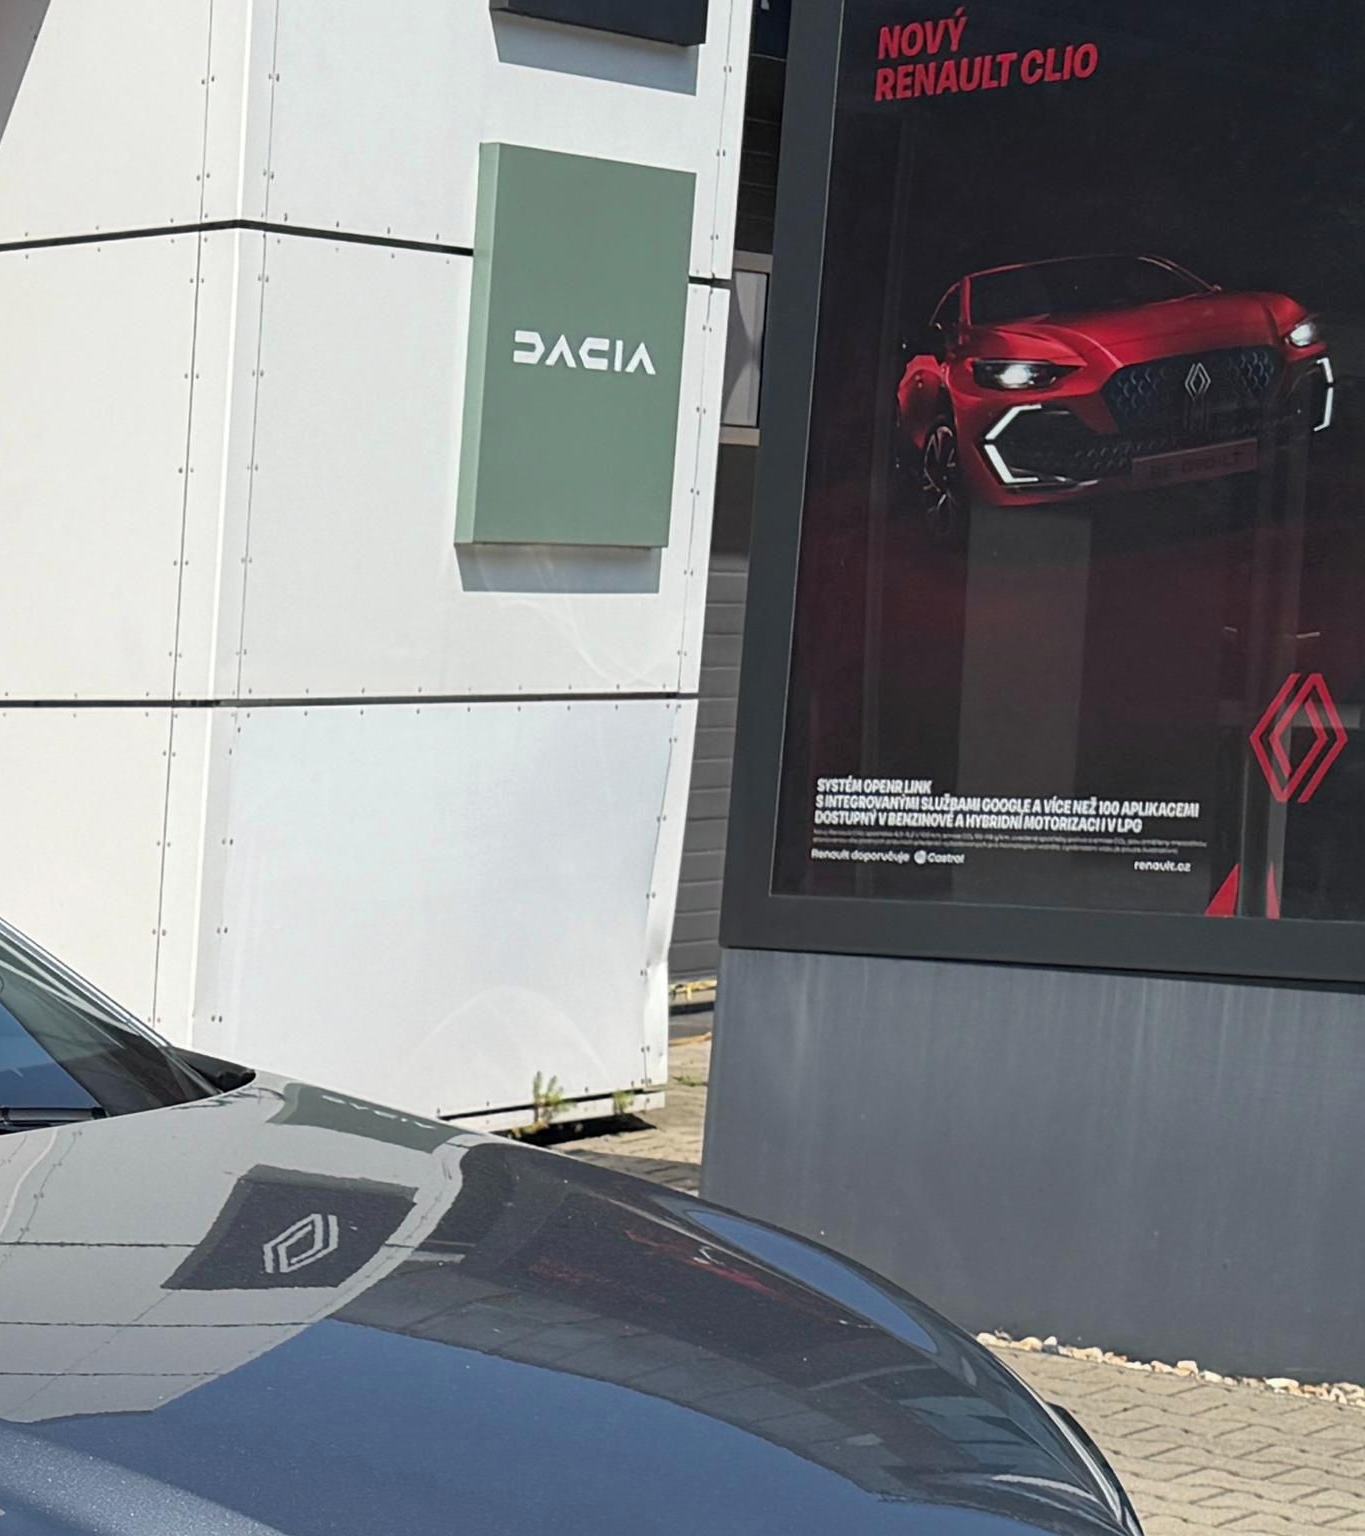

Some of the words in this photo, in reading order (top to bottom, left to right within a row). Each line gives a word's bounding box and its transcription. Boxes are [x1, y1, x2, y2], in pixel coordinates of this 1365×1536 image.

[877, 6, 968, 60] NOVÝ
[874, 52, 1018, 102] RENAULT
[1021, 42, 1098, 85] CLIO
[513, 330, 656, 375] DACIA
[817, 775, 862, 793] SYSTÉM
[863, 778, 903, 794] OPENR
[904, 779, 933, 794] LINK
[815, 794, 824, 808] S
[825, 793, 920, 811] INTEGROVANÝMI
[921, 793, 981, 812] SLUŽBAMI
[981, 797, 1032, 814] GOOGLE
[1032, 799, 1042, 814] A
[1043, 795, 1071, 815] VÍCE
[1072, 796, 1097, 815] NEŽ
[1098, 799, 1119, 816] 100
[1120, 801, 1200, 818] APLIKACEMI
[814, 809, 878, 826] DOSTUPNÝ
[878, 811, 888, 826] V
[887, 810, 954, 828] BENZINOVÉ
[954, 813, 965, 828] A
[965, 811, 1023, 830] HYBRIDNÍ
[1023, 815, 1100, 833] MOTORIZACI
[1107, 818, 1118, 833] V
[1118, 818, 1143, 833] LPG
[811, 848, 850, 861] Renault
[851, 850, 910, 864] doporučuje
[927, 852, 966, 864] Castrol
[1133, 860, 1191, 872] renault.cz
